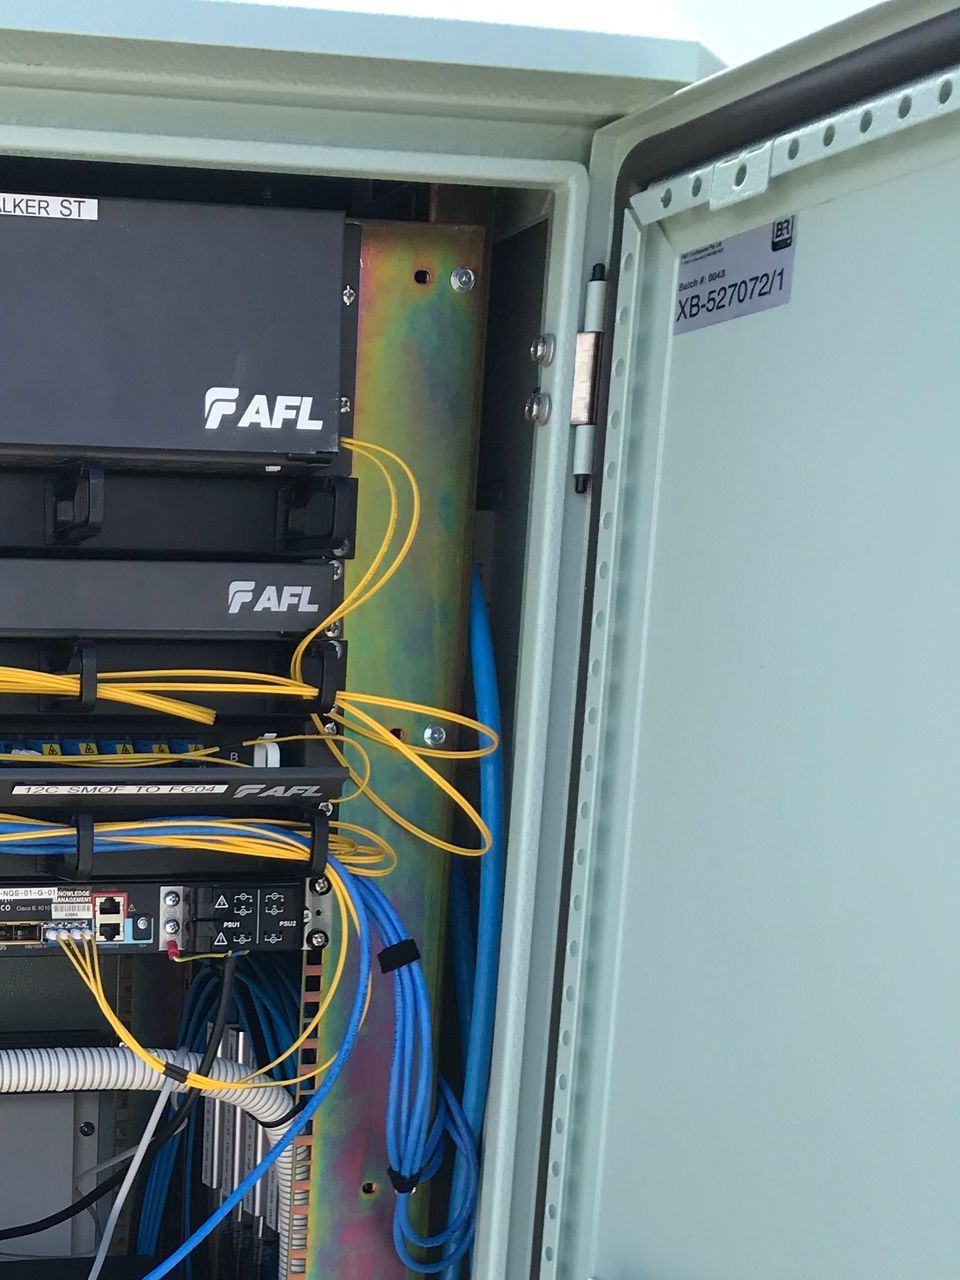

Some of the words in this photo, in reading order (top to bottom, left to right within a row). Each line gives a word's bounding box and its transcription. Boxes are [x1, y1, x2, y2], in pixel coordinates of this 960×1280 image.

[59, 198, 87, 218] ST
[677, 267, 785, 322] XB-527072/1
[237, 394, 324, 430] AFL
[253, 585, 319, 612] AFL
[230, 752, 239, 762] B
[23, 786, 60, 794] 12C
[68, 786, 124, 794] SMOF
[135, 785, 162, 794] TO
[257, 784, 323, 797] AFL
[223, 921, 240, 929] PSU1
